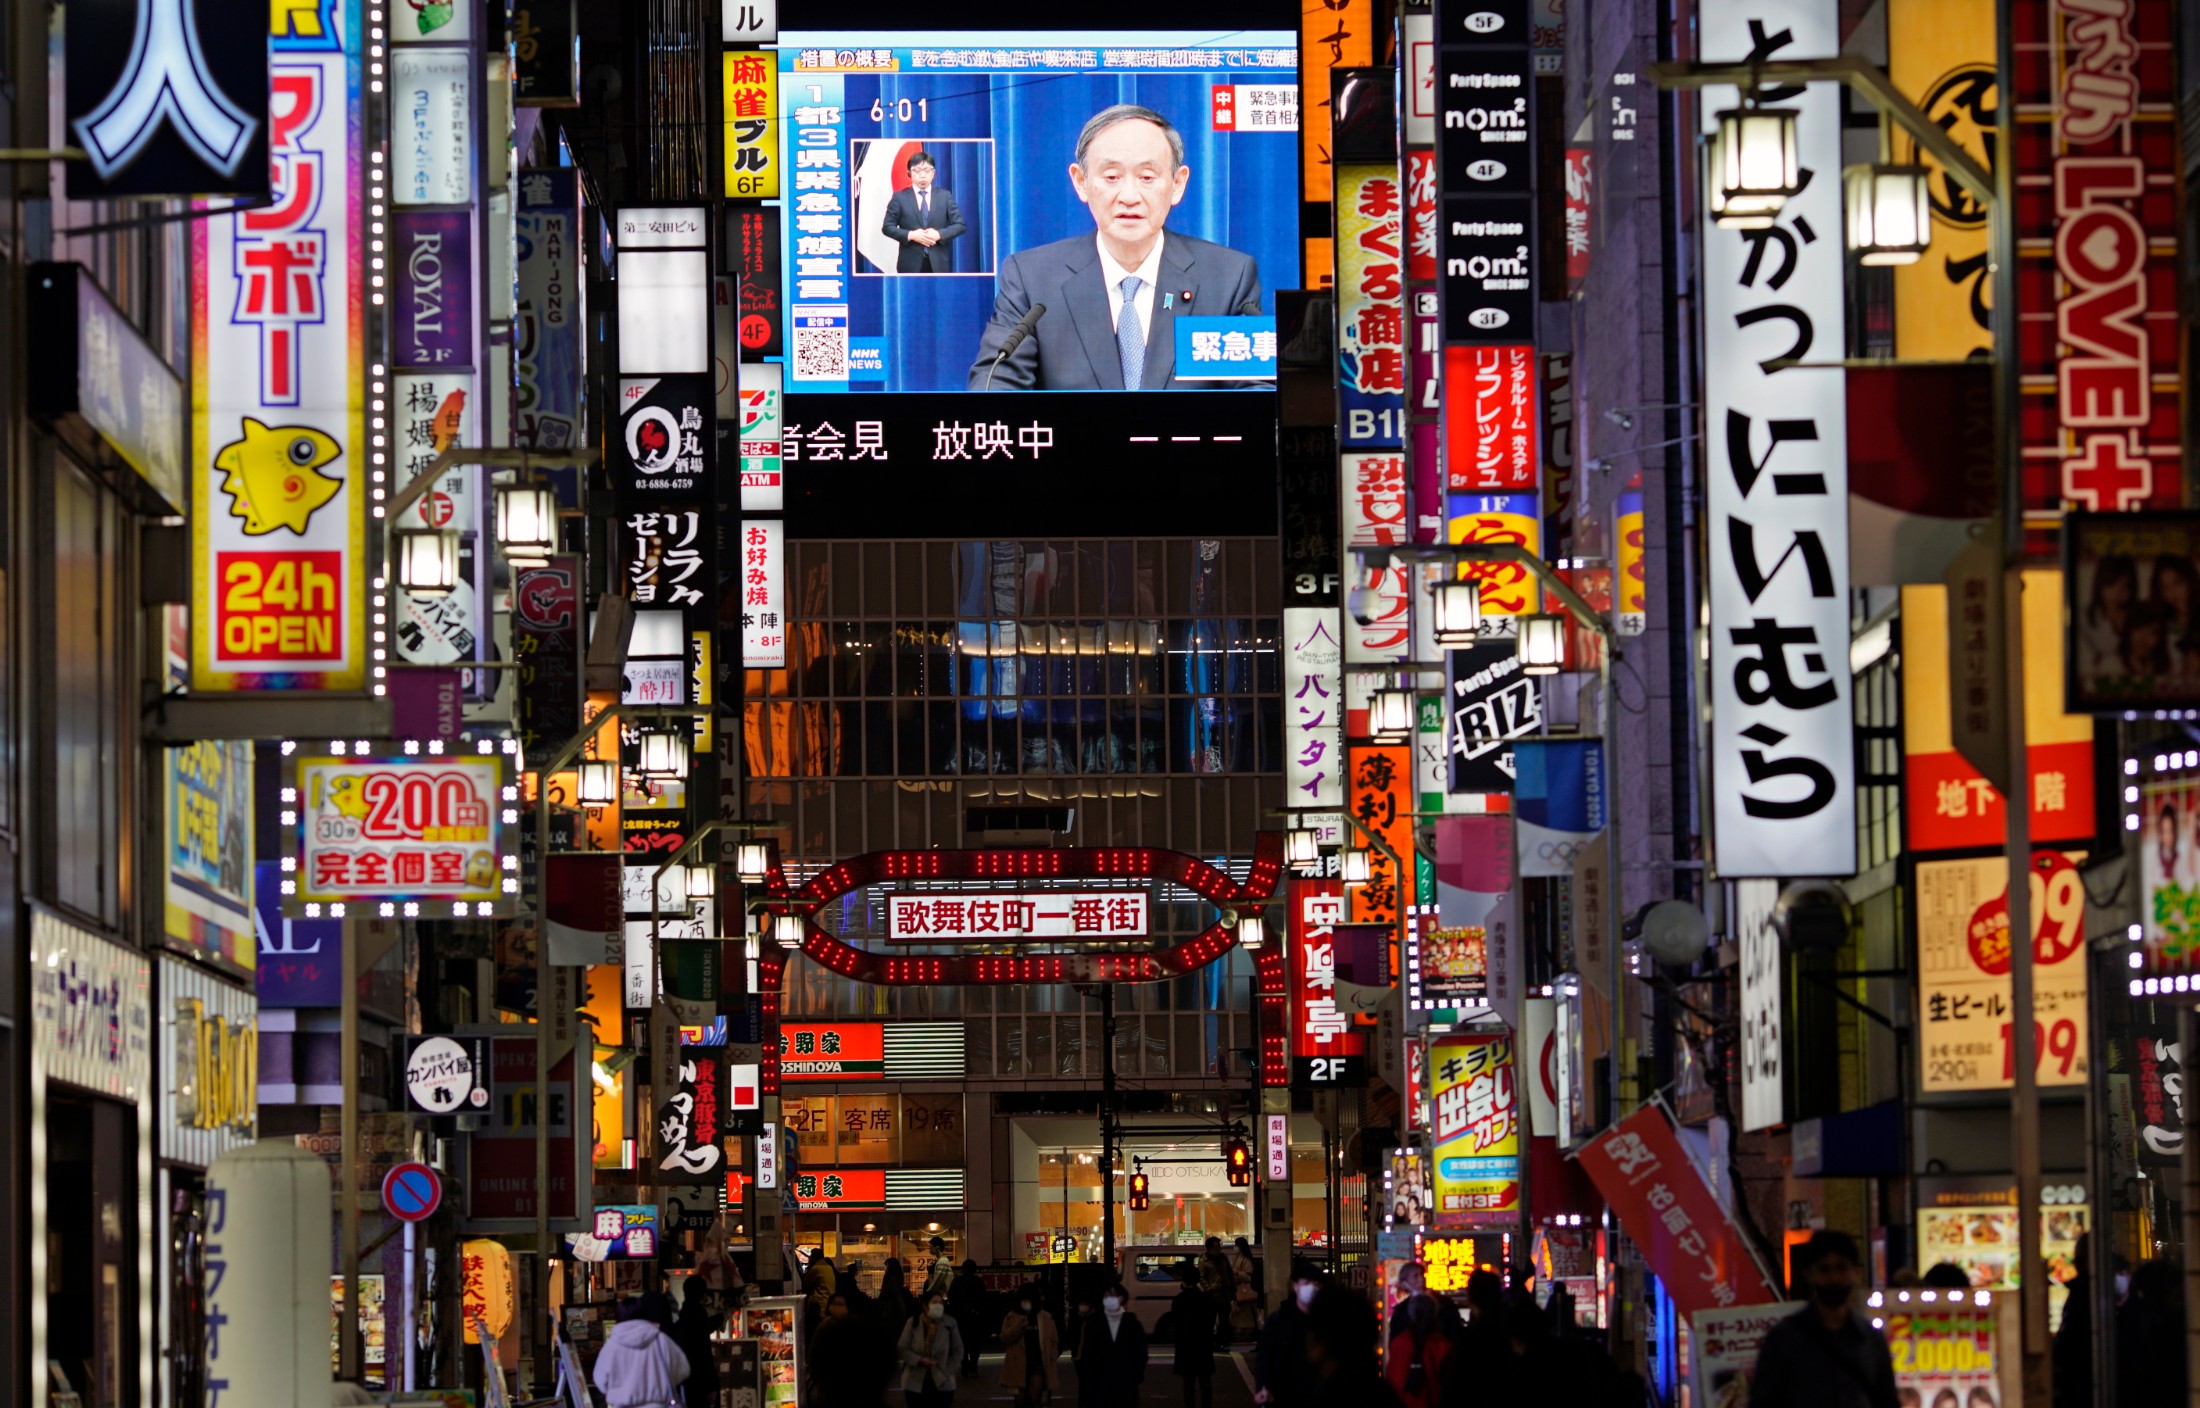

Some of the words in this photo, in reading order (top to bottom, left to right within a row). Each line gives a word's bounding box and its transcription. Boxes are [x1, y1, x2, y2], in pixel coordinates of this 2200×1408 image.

[1475, 16, 1494, 28] 5F
[801, 50, 893, 69] 措置の概要
[1450, 74, 1485, 89] Party
[1486, 74, 1521, 88] Space
[732, 55, 767, 173] 麻雀ブル
[870, 97, 928, 122] 6:01
[1215, 91, 1232, 125] 中継
[1476, 163, 1496, 177] 4F
[737, 176, 764, 194] 6F
[793, 85, 843, 299] 1都3県緊急事態宣言
[624, 220, 699, 234] 第二安田ビル
[1453, 222, 1488, 237] Party
[1487, 222, 1523, 237] Space
[546, 219, 563, 324] MAH-JONG
[409, 232, 442, 346] ROYAL
[1358, 177, 1404, 395] まぐろ商店
[807, 317, 834, 327] 配信中
[1479, 312, 1499, 325] 3F
[743, 323, 765, 341] 4F
[414, 348, 452, 364] 2F
[848, 359, 883, 370] NEWS
[850, 349, 880, 359] NHK
[625, 386, 645, 400] 4F
[1474, 350, 1502, 487] リフレッシュ
[1511, 433, 1529, 482] ホステル
[1726, 19, 1839, 821] とかつにいむら
[740, 443, 773, 455] たばこ
[932, 420, 1053, 460] 放映中
[445, 410, 463, 495] 台湾理
[675, 457, 704, 474] 酒場
[747, 458, 763, 471] 酒
[635, 479, 693, 489] 03-6886-6759
[741, 474, 771, 486] ATM
[1479, 496, 1510, 512] 1F
[746, 527, 769, 606] お好み焼
[225, 561, 336, 610] 24h
[1295, 573, 1339, 595] 3F
[741, 612, 778, 630] 本陣
[224, 616, 334, 653] OPEN
[760, 636, 782, 647] 8F
[630, 668, 681, 680] さつま居酒屋
[1454, 666, 1491, 698] Party
[638, 680, 675, 701] 酔月
[438, 682, 454, 734] TOKYO
[1422, 703, 1438, 718] 肉
[1294, 674, 1330, 798] バンタイ
[1584, 748, 1600, 793] TOKYO
[1936, 772, 2066, 819] 地下階
[1586, 794, 1601, 829] 2020
[316, 851, 468, 886] 完全個室
[896, 897, 1142, 936] 歌舞伎町一番街
[1377, 932, 1388, 960] TOKYO
[1303, 891, 1348, 1044] 安楽亭
[1379, 961, 1389, 984] 2020
[630, 964, 645, 1007] 一番街
[703, 977, 712, 999] 2020
[1929, 990, 2006, 1023] 生ビール
[406, 1056, 473, 1084] カンパイ屋
[1309, 1059, 1347, 1082] 2F
[1439, 1036, 1511, 1083] キラリ
[1929, 1059, 1979, 1082] 290円
[693, 1057, 718, 1145] 東京豚骨
[796, 1108, 826, 1132] 2F
[844, 1108, 892, 1132] 客席
[1271, 1119, 1283, 1176] 劇場通り
[479, 1177, 528, 1193] ONLINE
[797, 1175, 843, 1198] 野家
[515, 1198, 533, 1213] B1
[1444, 1194, 1502, 1210] 受付3F
[626, 1214, 655, 1226] フリー
[594, 1210, 656, 1258] 麻雀
[1423, 1239, 1475, 1265] 地域
